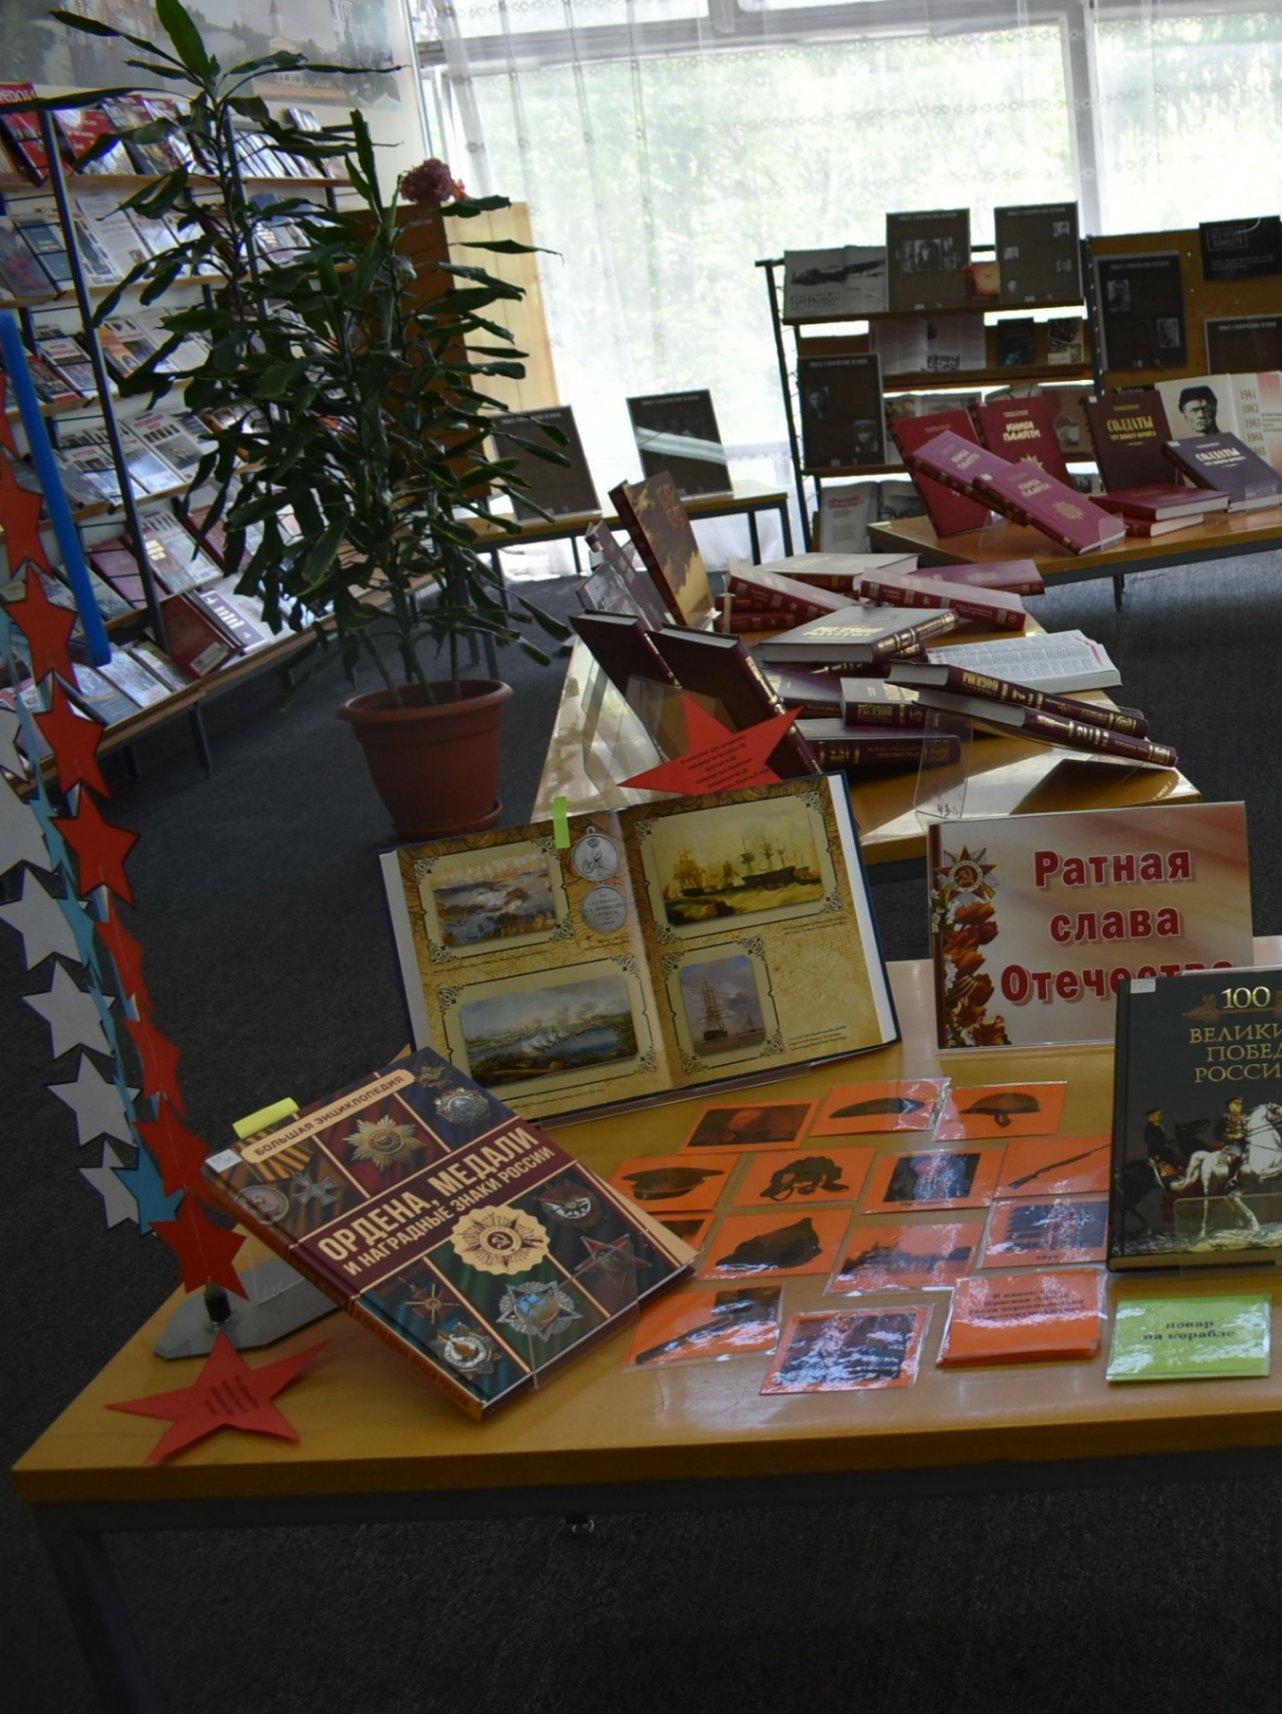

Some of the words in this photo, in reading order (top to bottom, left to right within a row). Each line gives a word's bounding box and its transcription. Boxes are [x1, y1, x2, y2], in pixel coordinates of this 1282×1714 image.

[1005, 421, 1034, 432] КНИГА
[1107, 416, 1153, 432] СОЛДАТЫ
[1003, 429, 1041, 441] ПАМЯТИ
[1195, 448, 1241, 460] СОЛДАТЫ
[1034, 850, 1192, 888] Ратная
[1050, 907, 1182, 943] слава
[1221, 985, 1271, 1009] 100
[254, 1122, 316, 1156] БОЛЬШАЯ
[313, 1075, 405, 1125] ЭНЦИКЛОПЕДИЯ
[318, 1190, 440, 1262] ОРДЕНА,
[427, 1126, 540, 1197] МЕДАЛИ
[342, 1262, 362, 1276] И
[357, 1206, 454, 1267] НАГРАДНЫЕ
[450, 1175, 503, 1213] ЗНАКИ
[500, 1146, 556, 1185] РОССИИ
[1165, 1320, 1214, 1330] повар
[1168, 1329, 1235, 1341] корабле
